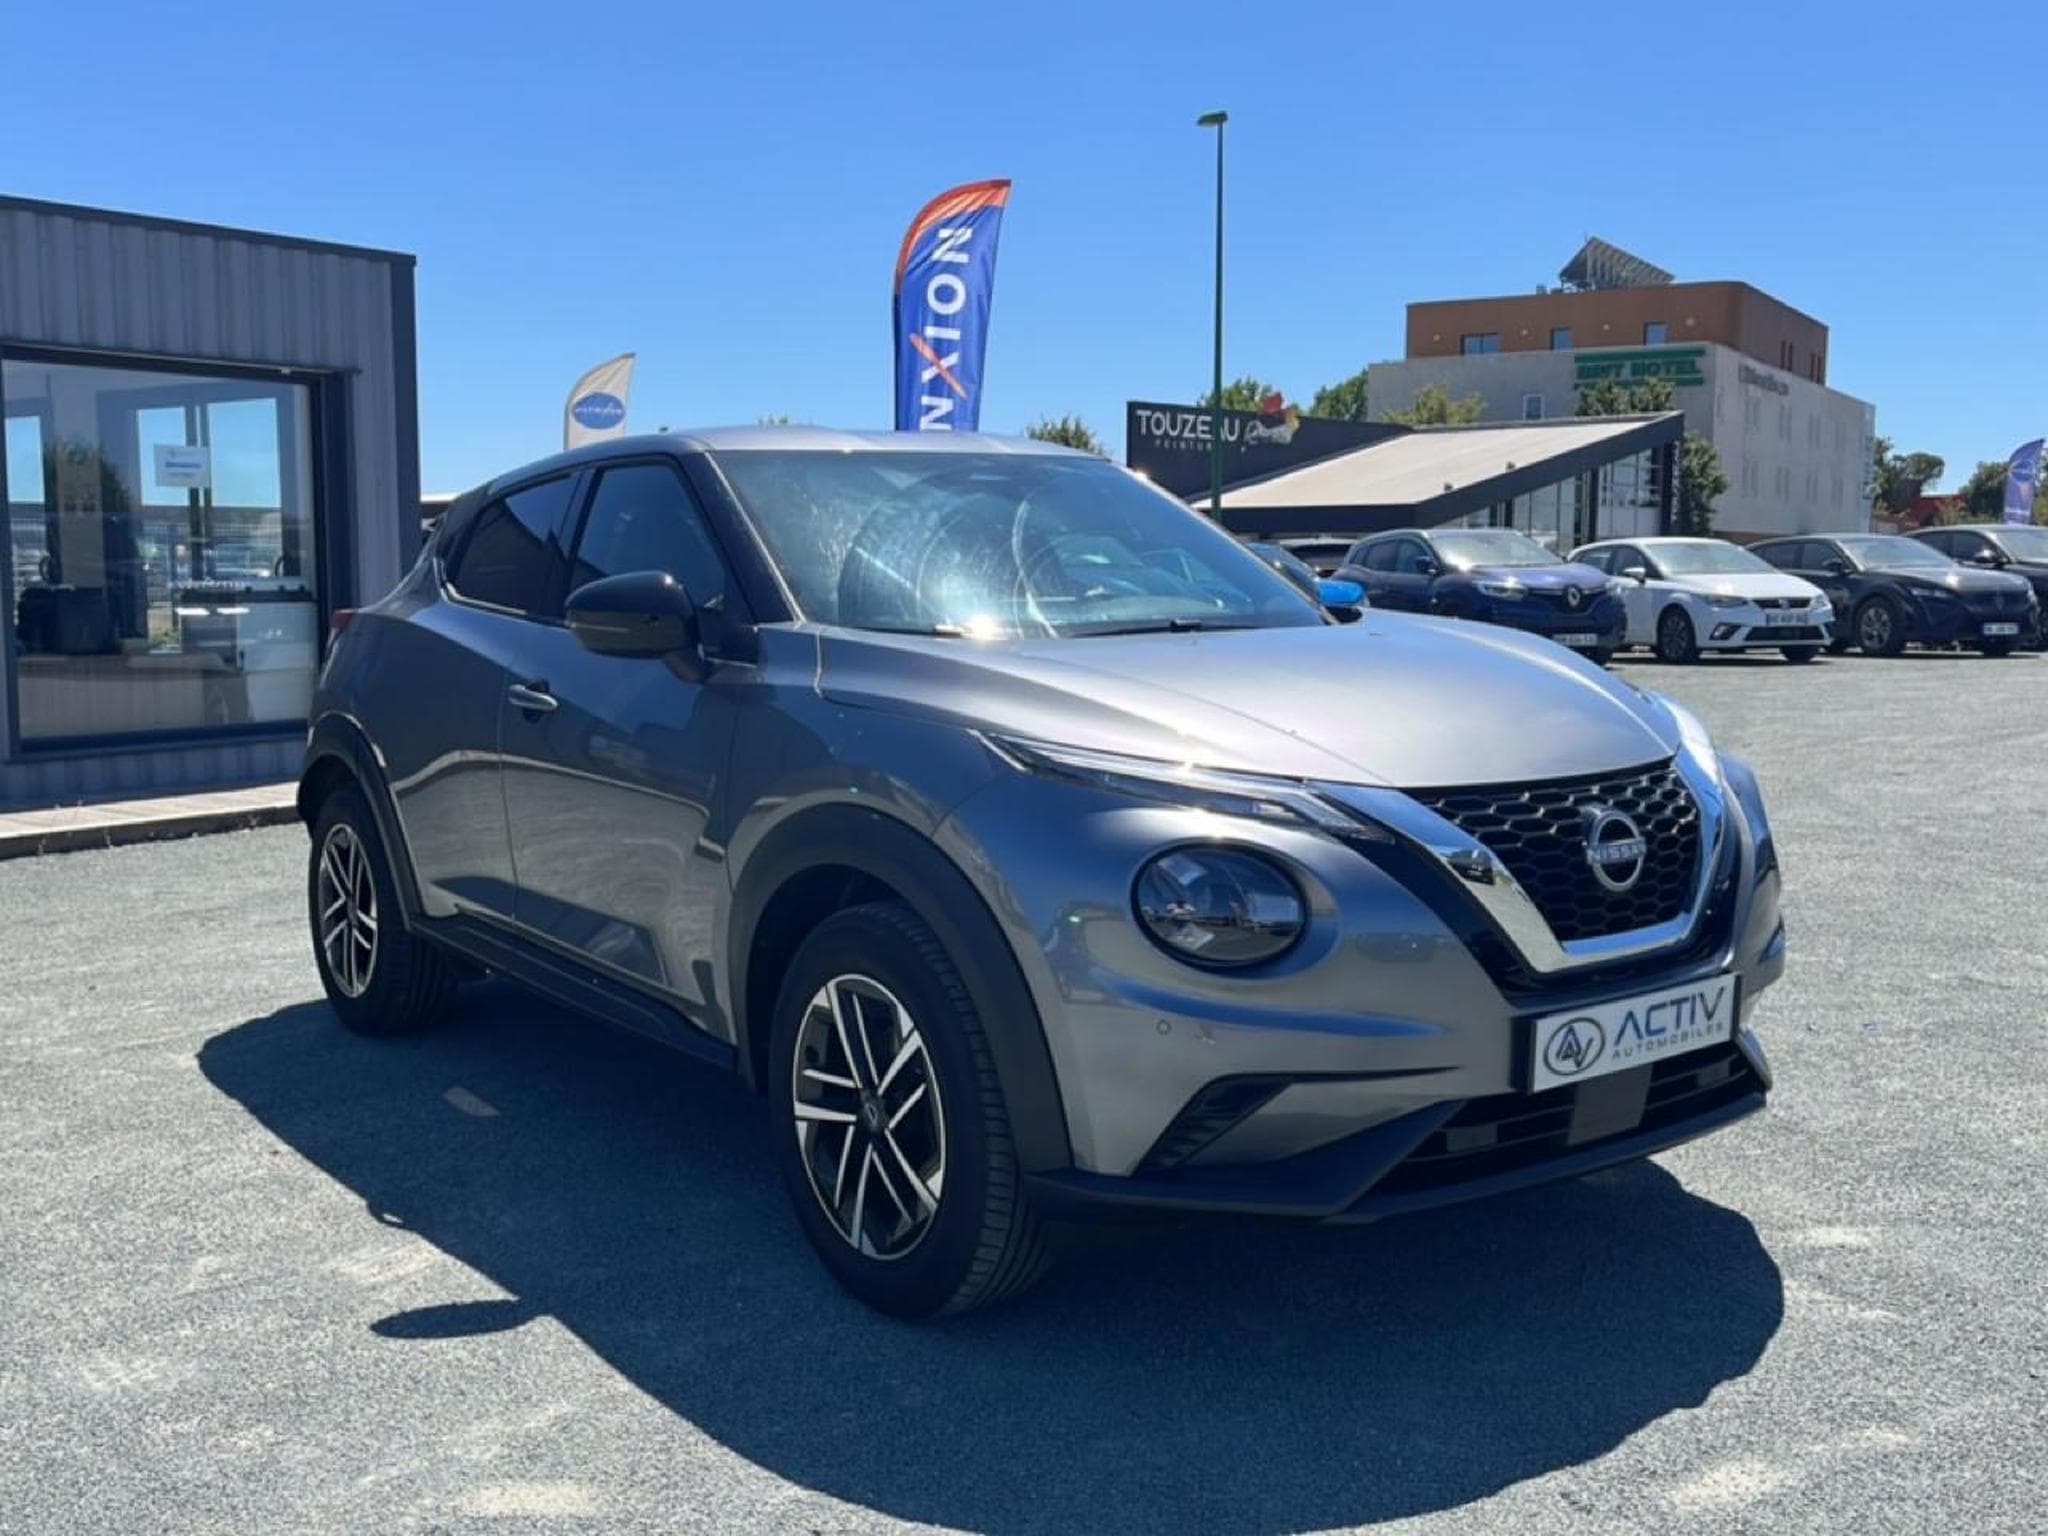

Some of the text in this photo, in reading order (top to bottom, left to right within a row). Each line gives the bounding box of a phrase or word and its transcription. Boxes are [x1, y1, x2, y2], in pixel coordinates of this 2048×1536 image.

[909, 227, 973, 432] NXION
[1612, 1021, 1724, 1060] AUTOMOBILES
[1614, 986, 1725, 1047] ACTIV
